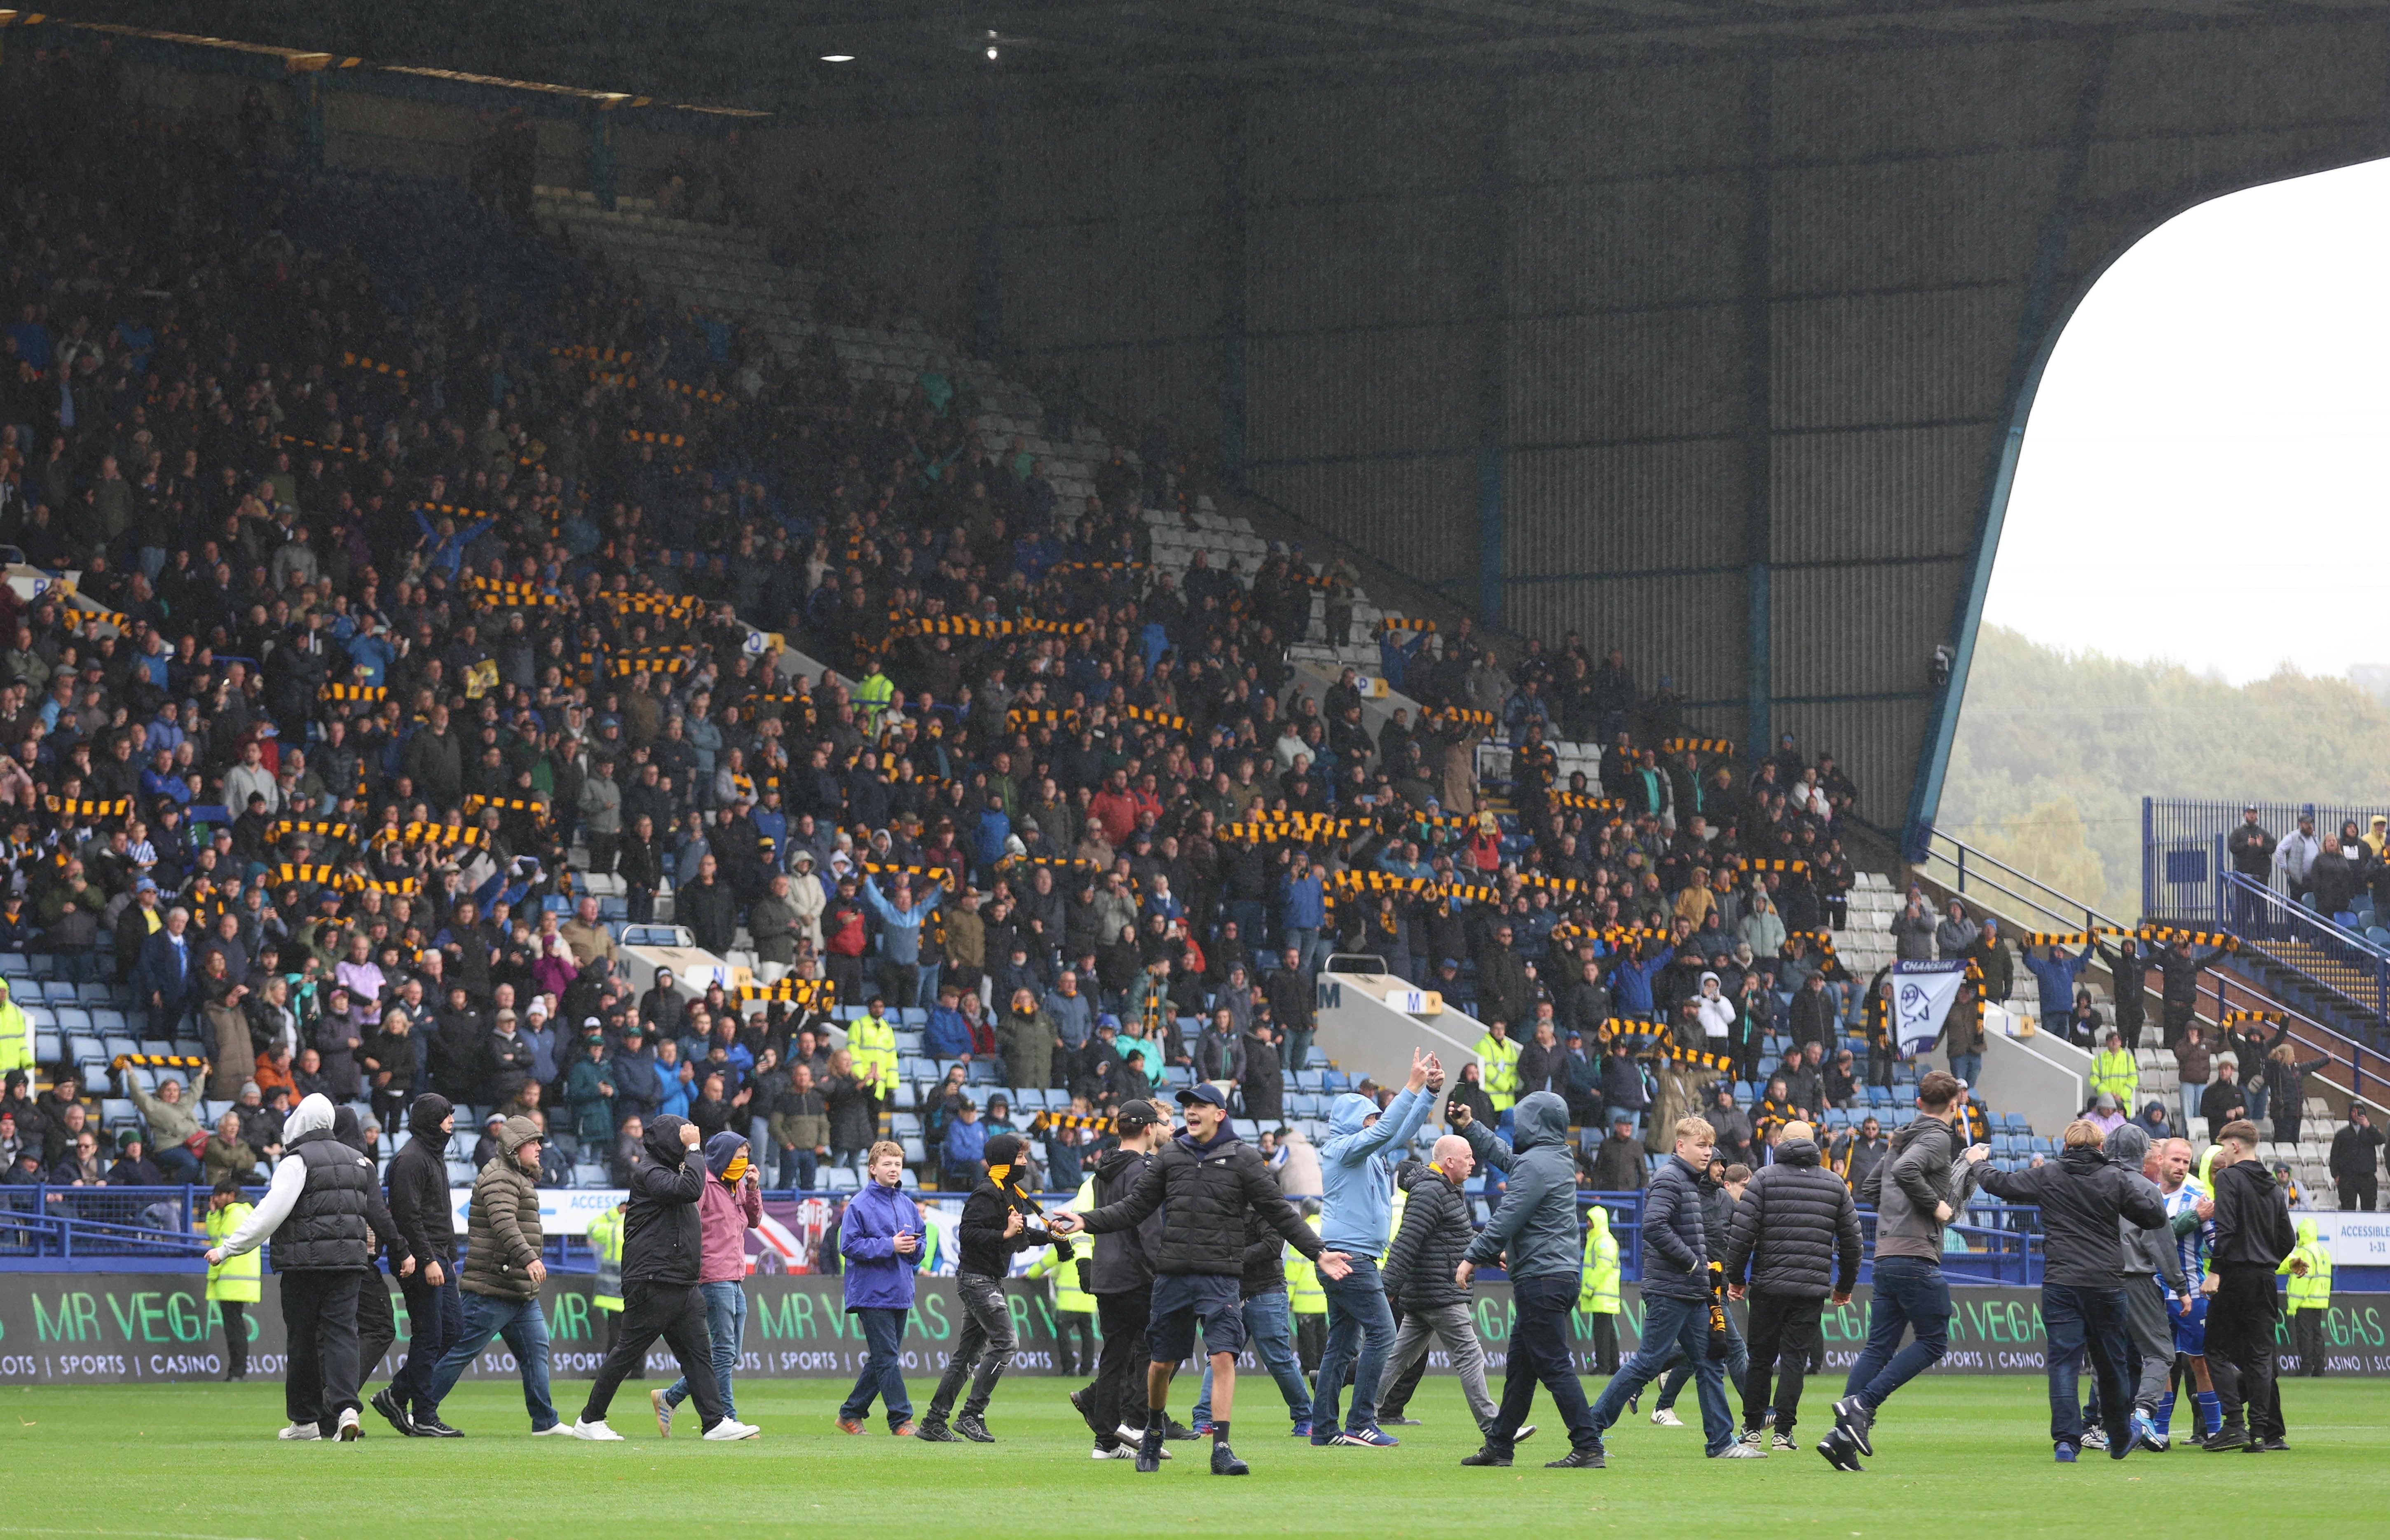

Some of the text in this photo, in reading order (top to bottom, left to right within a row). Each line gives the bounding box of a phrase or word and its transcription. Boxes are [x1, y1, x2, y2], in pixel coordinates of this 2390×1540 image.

[748, 632, 761, 651] Q
[1359, 677, 1367, 694] P
[619, 960, 631, 979] N
[713, 965, 725, 987] N
[1319, 983, 1341, 1009] M
[1408, 991, 1420, 1013] M
[2006, 1015, 2013, 1036] L
[2341, 1226, 2390, 1237] ACCESSIBLE
[2369, 1241, 2386, 1252] 1-31
[32, 1292, 102, 1342] MR
[757, 1292, 951, 1341] MR VAS
[1007, 1294, 1034, 1340] R
[1948, 1300, 2049, 1344] R VEGA
[2275, 1307, 2385, 1346] R GAS
[0, 1354, 288, 1375] OTS SPORTS CASINO SLOT
[485, 1352, 607, 1373] SLO SPORT
[645, 1352, 681, 1371] ASIN
[733, 1351, 762, 1371] OTS
[780, 1351, 837, 1371] SPORTS
[858, 1350, 918, 1370] CNO
[1008, 1351, 1052, 1369] ORTS
[1999, 1351, 2045, 1369] CASINO
[2277, 1355, 2390, 1372] ORT ASINO SLO
